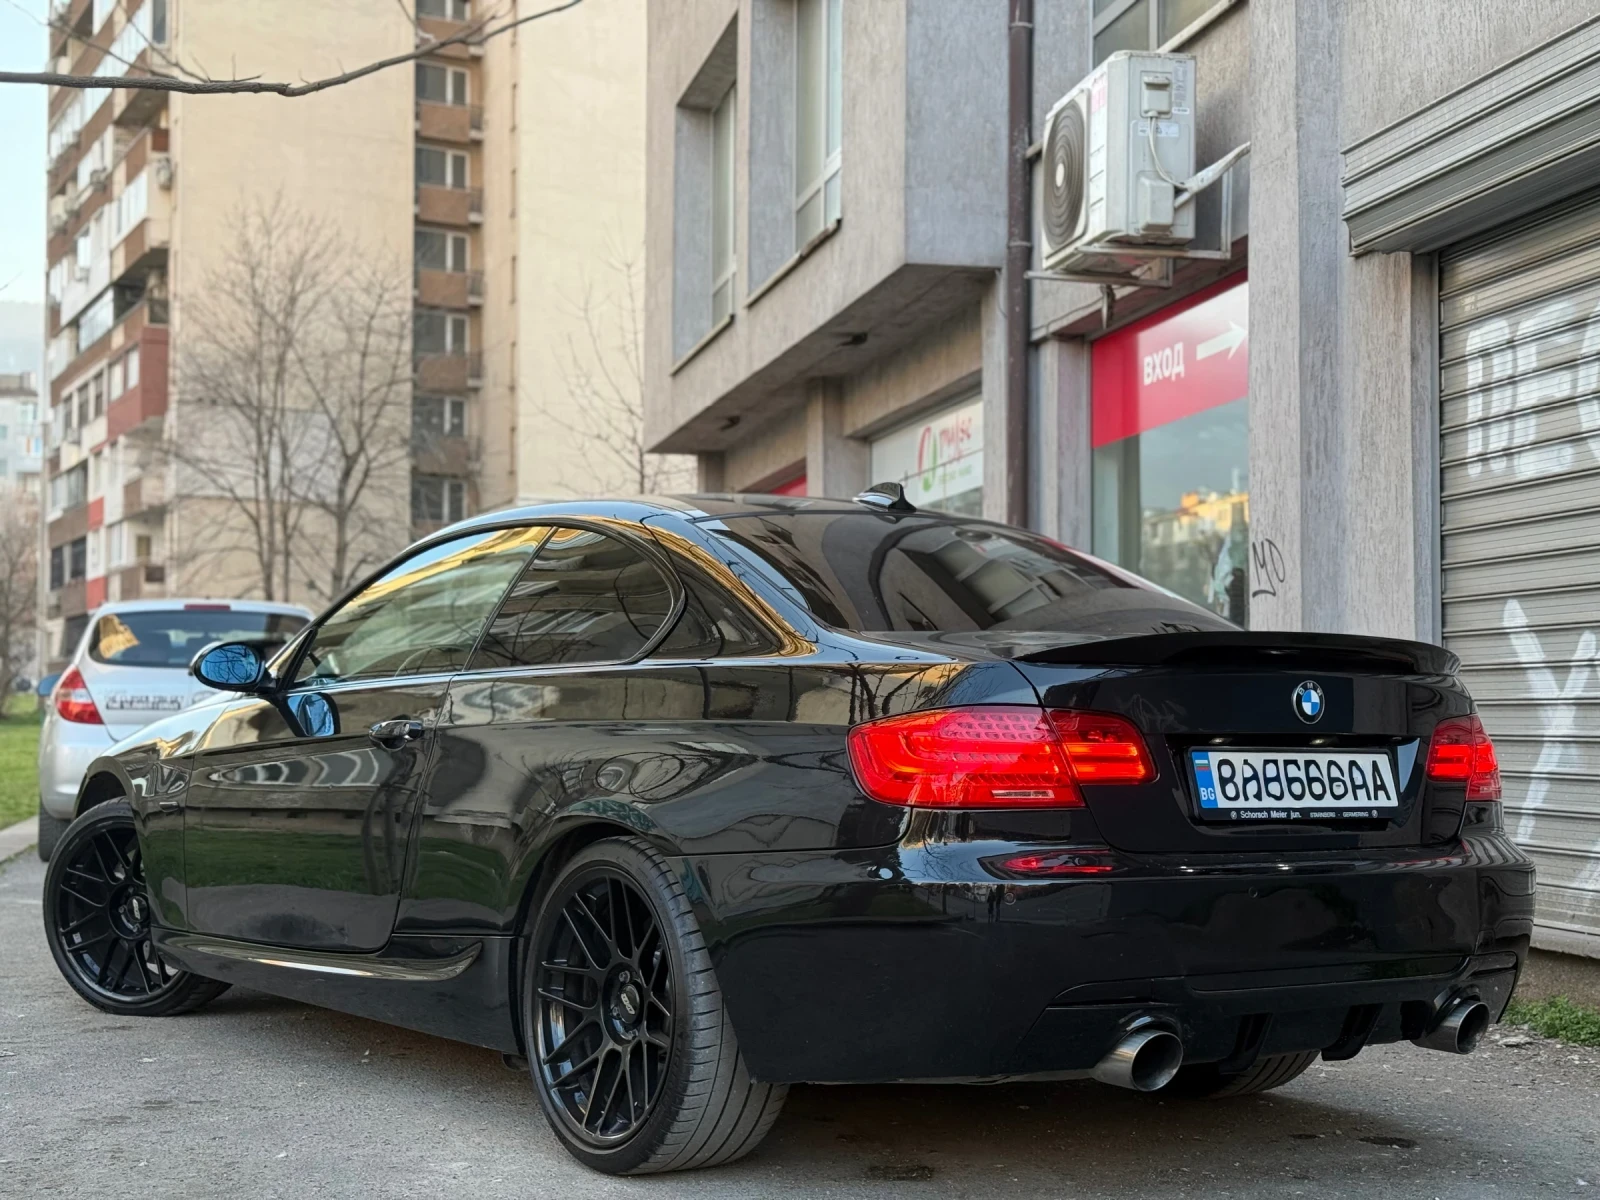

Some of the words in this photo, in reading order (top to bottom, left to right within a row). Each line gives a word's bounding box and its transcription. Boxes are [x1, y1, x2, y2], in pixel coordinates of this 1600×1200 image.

[1143, 341, 1185, 386] ВХОД
[1200, 787, 1216, 801] BG
[1240, 810, 1269, 819] Schorsch
[1270, 810, 1288, 819] Meier
